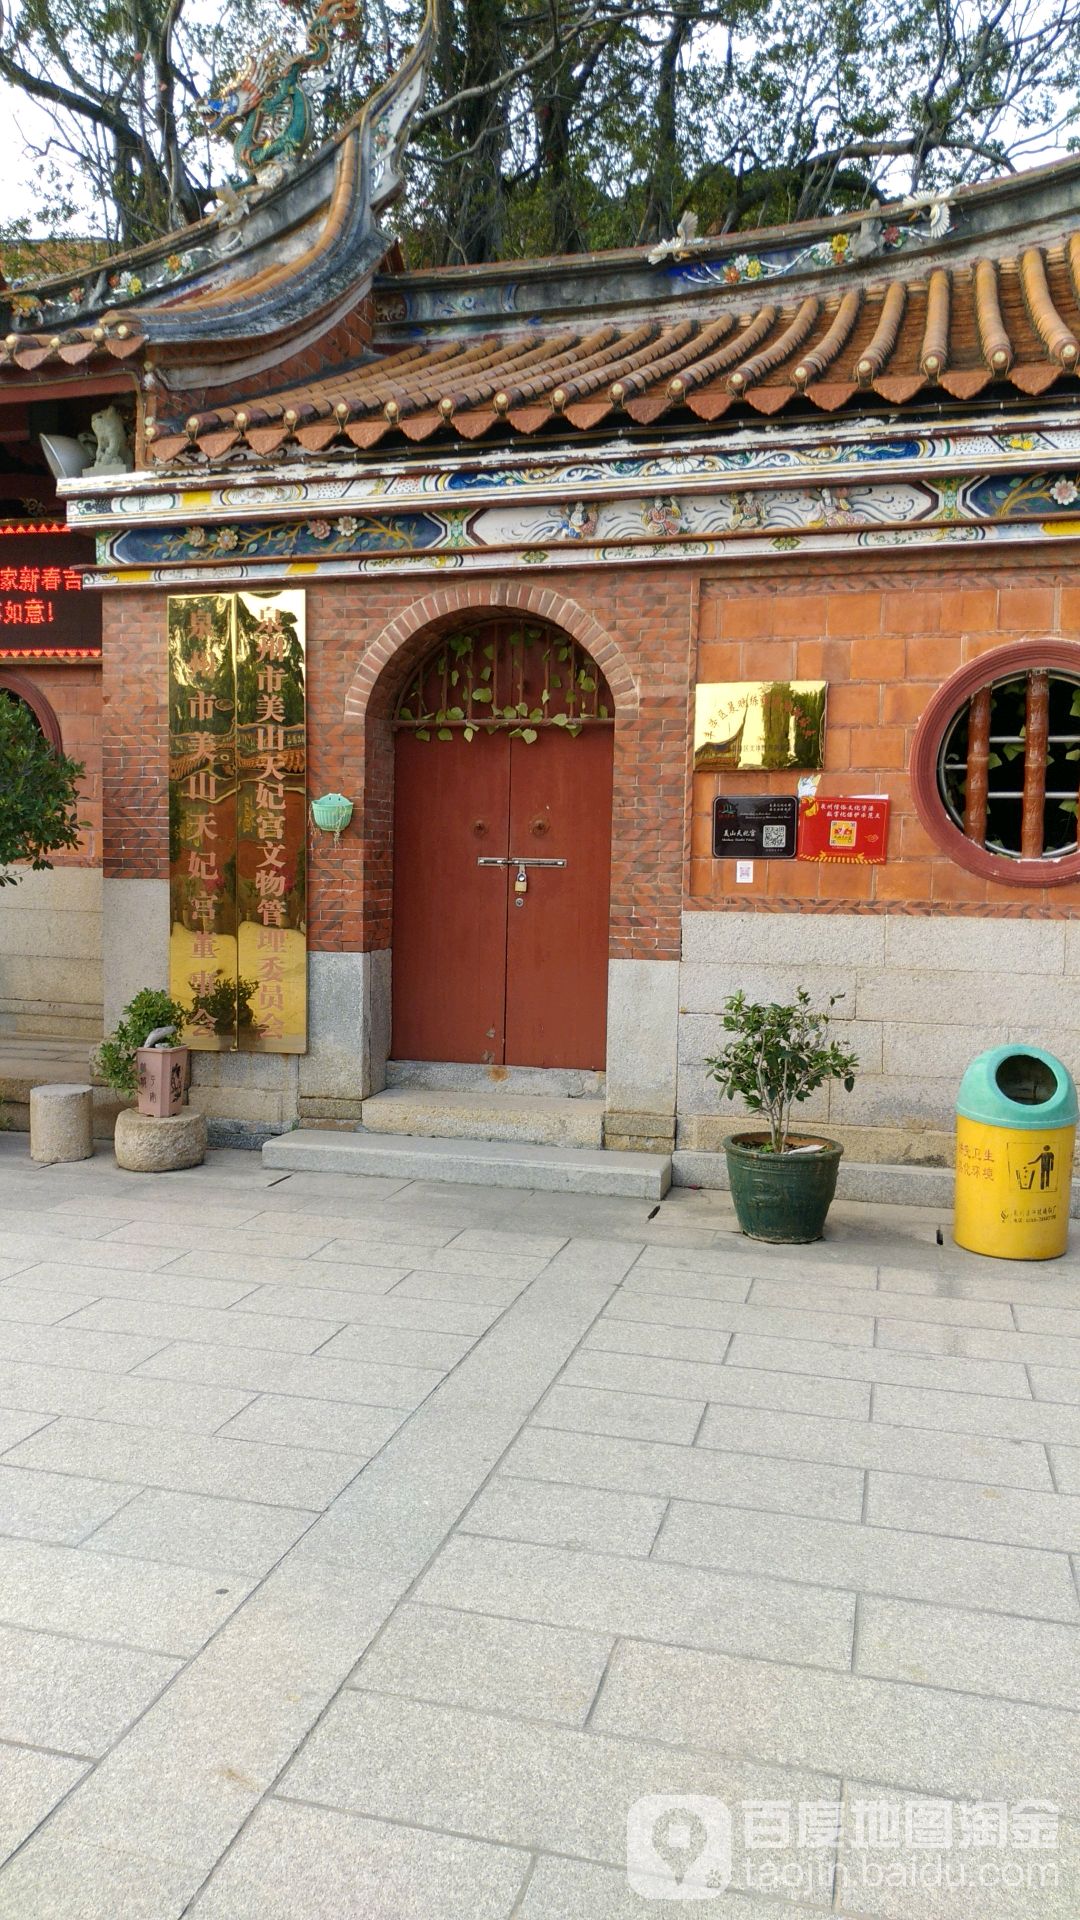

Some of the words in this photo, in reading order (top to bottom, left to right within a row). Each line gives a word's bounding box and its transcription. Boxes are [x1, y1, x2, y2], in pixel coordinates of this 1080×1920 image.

[187, 607, 219, 1038] 泉州市美山天妃宫董事会
[255, 606, 289, 1040] 泉州市美山天妃宫文物管理委员会
